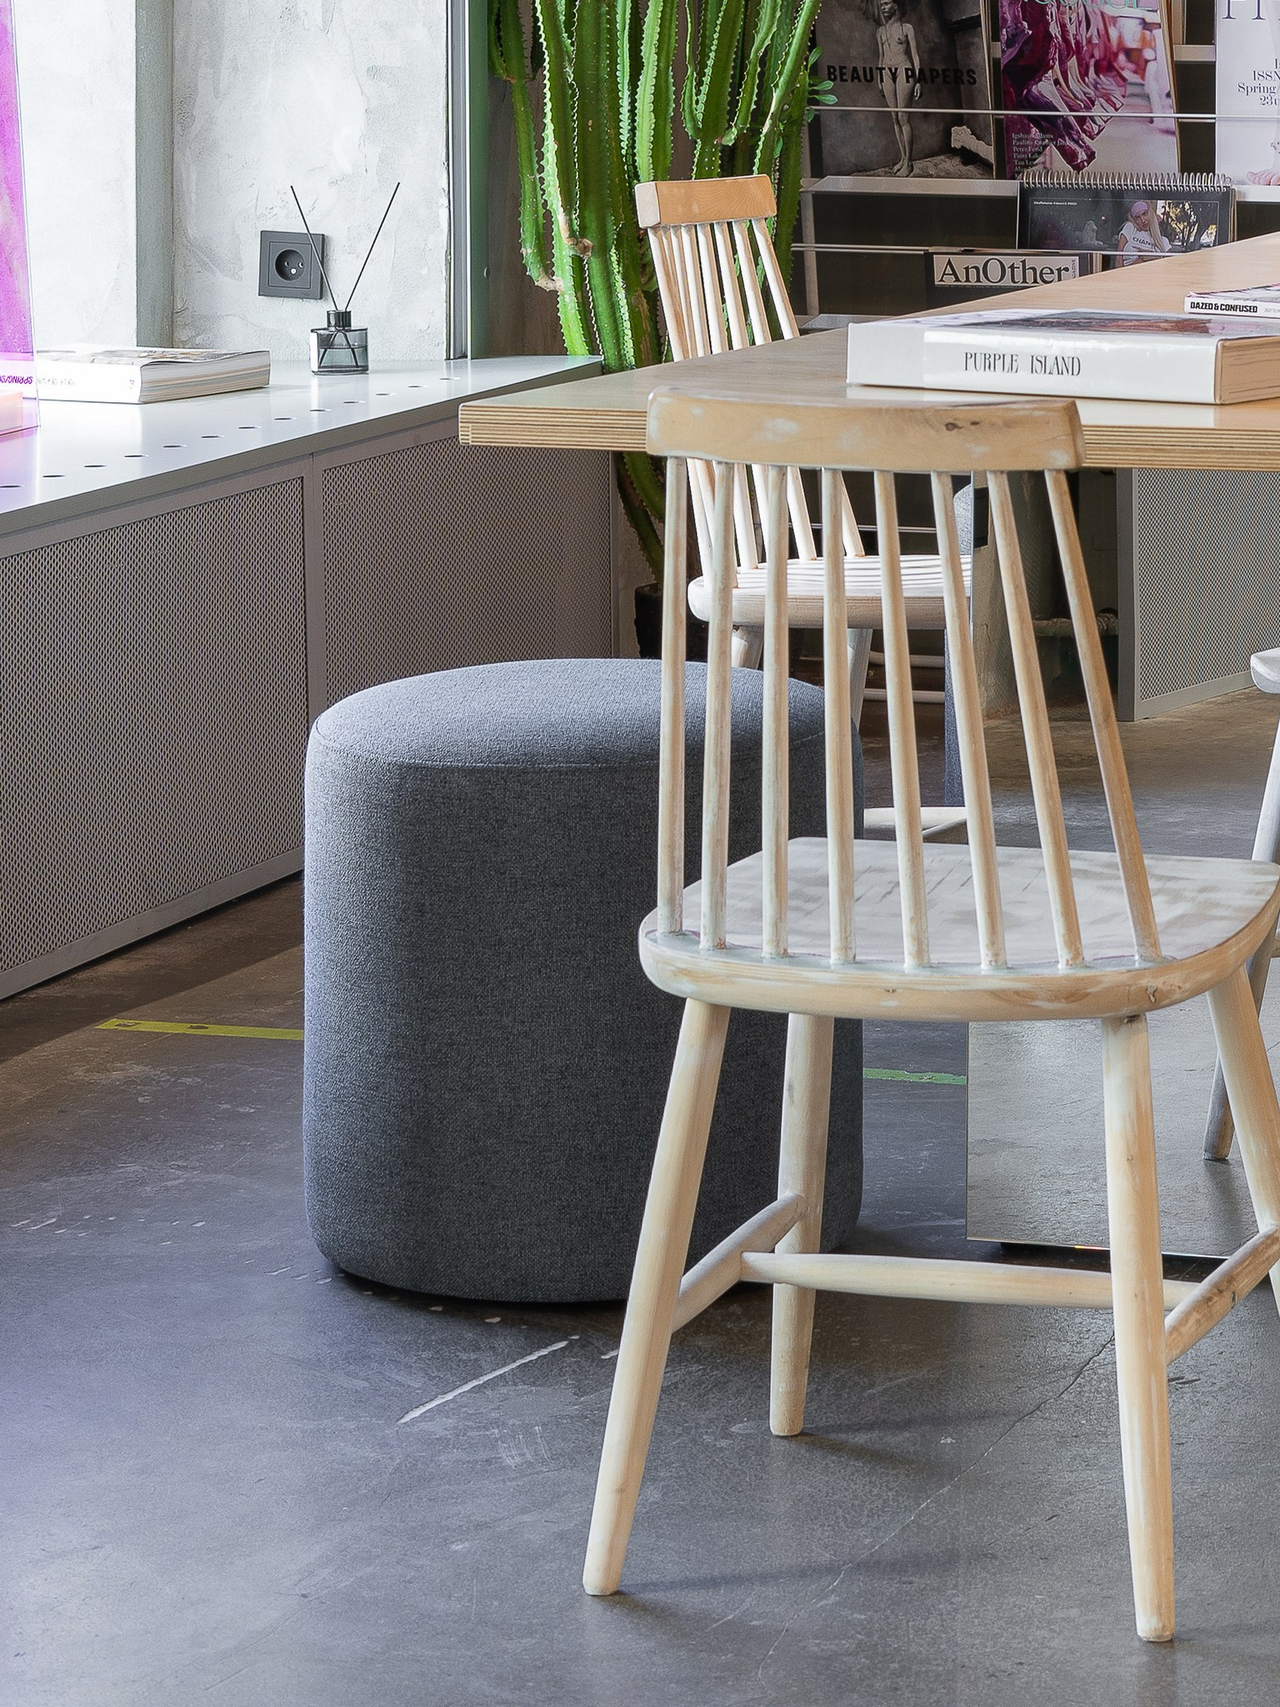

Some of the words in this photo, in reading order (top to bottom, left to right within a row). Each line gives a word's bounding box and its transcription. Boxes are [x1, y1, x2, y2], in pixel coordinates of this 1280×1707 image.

[827, 65, 900, 84] BEAUTY
[904, 67, 977, 86] PAPERS
[938, 257, 1070, 285] AnOther
[1190, 301, 1213, 310] DAZED
[1213, 302, 1219, 310] &
[1220, 303, 1258, 313] CONFUSED
[964, 352, 1019, 374] PURPLE
[1030, 354, 1081, 376] ISLAND
